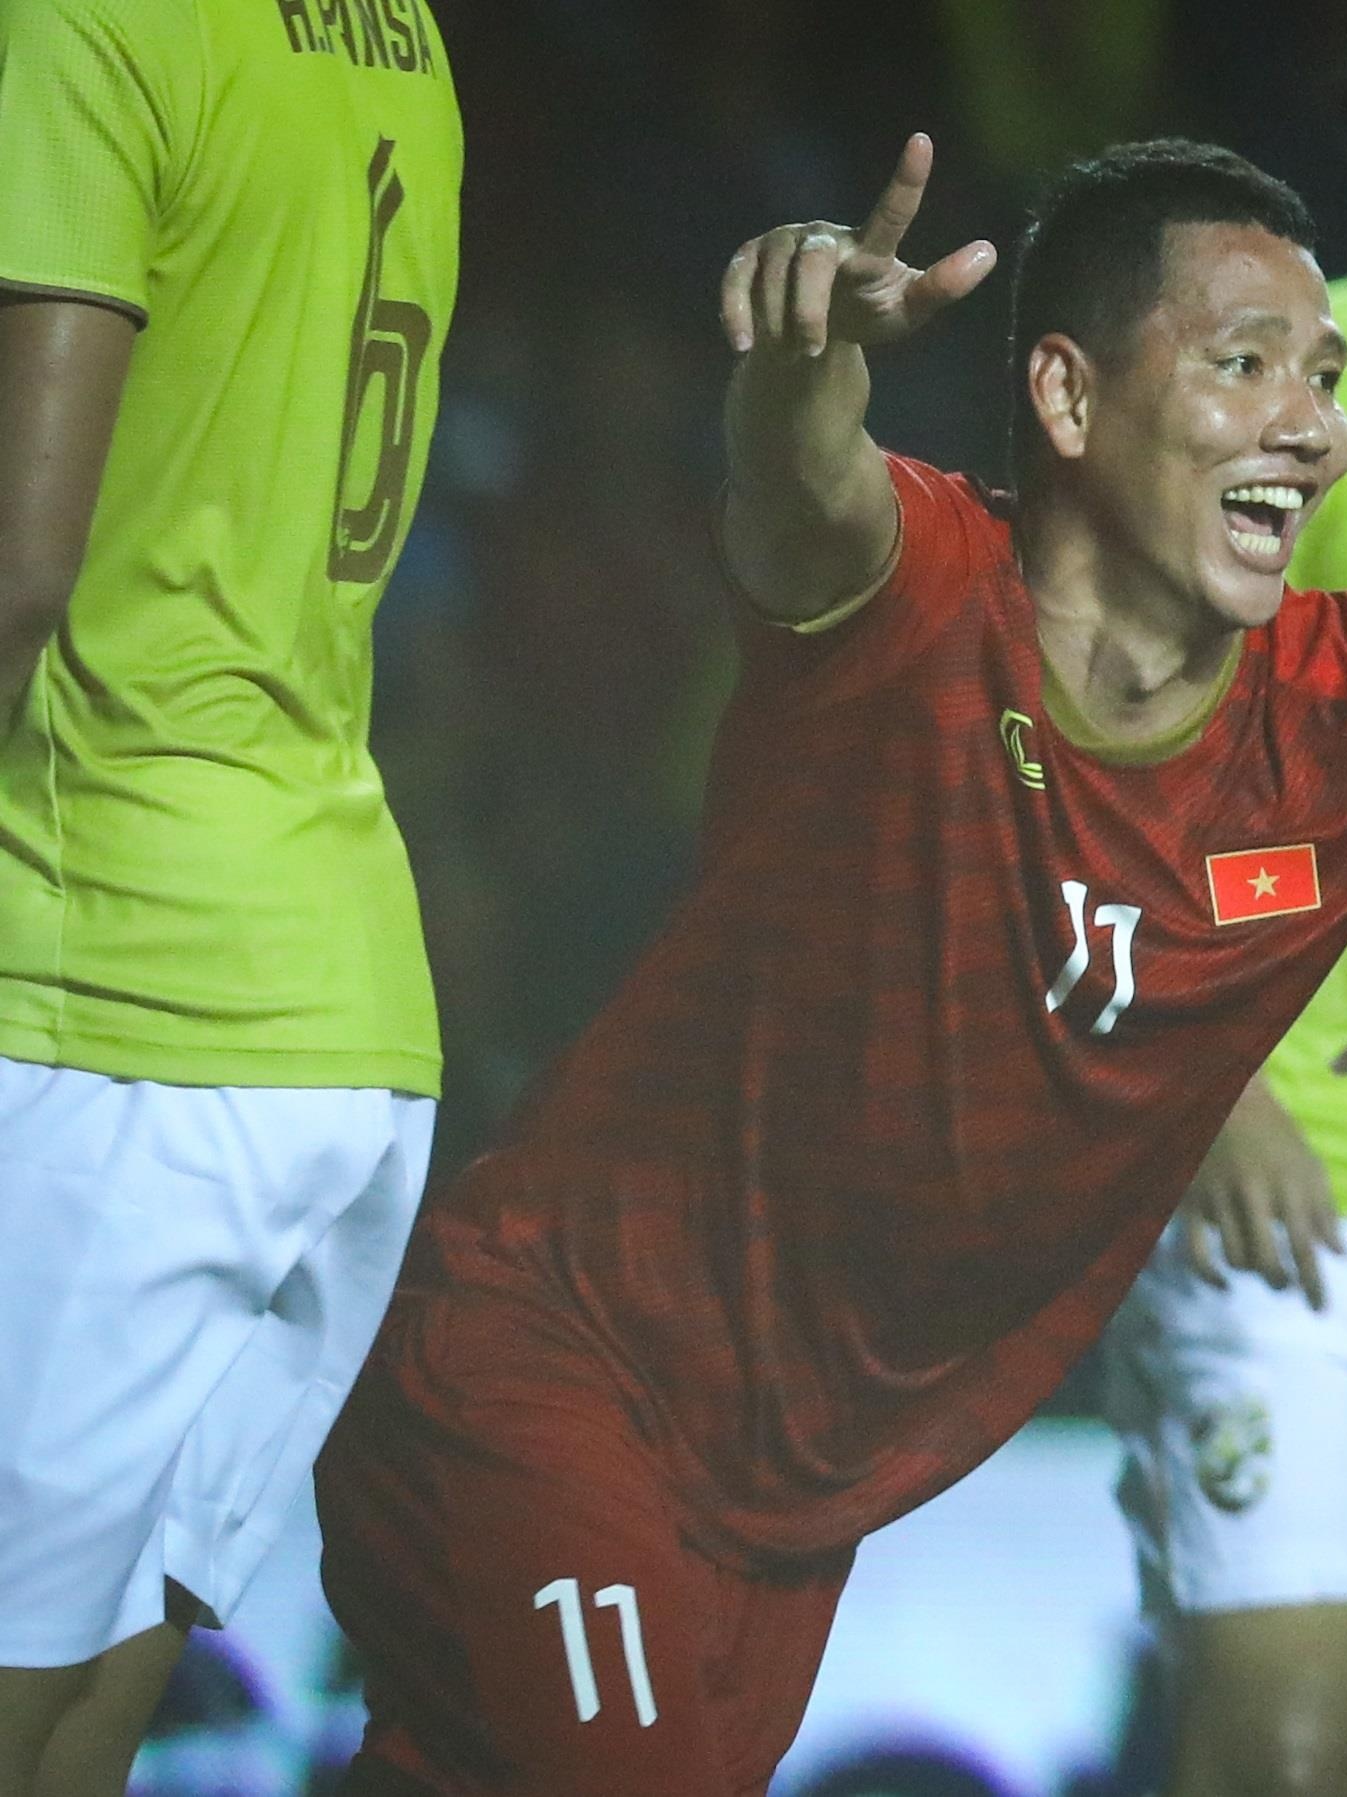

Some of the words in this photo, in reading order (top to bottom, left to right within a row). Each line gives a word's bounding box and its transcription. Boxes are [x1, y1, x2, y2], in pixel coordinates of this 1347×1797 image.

[326, 131, 433, 584] 6
[1045, 879, 1142, 1034] 11
[533, 1577, 659, 1728] 11
